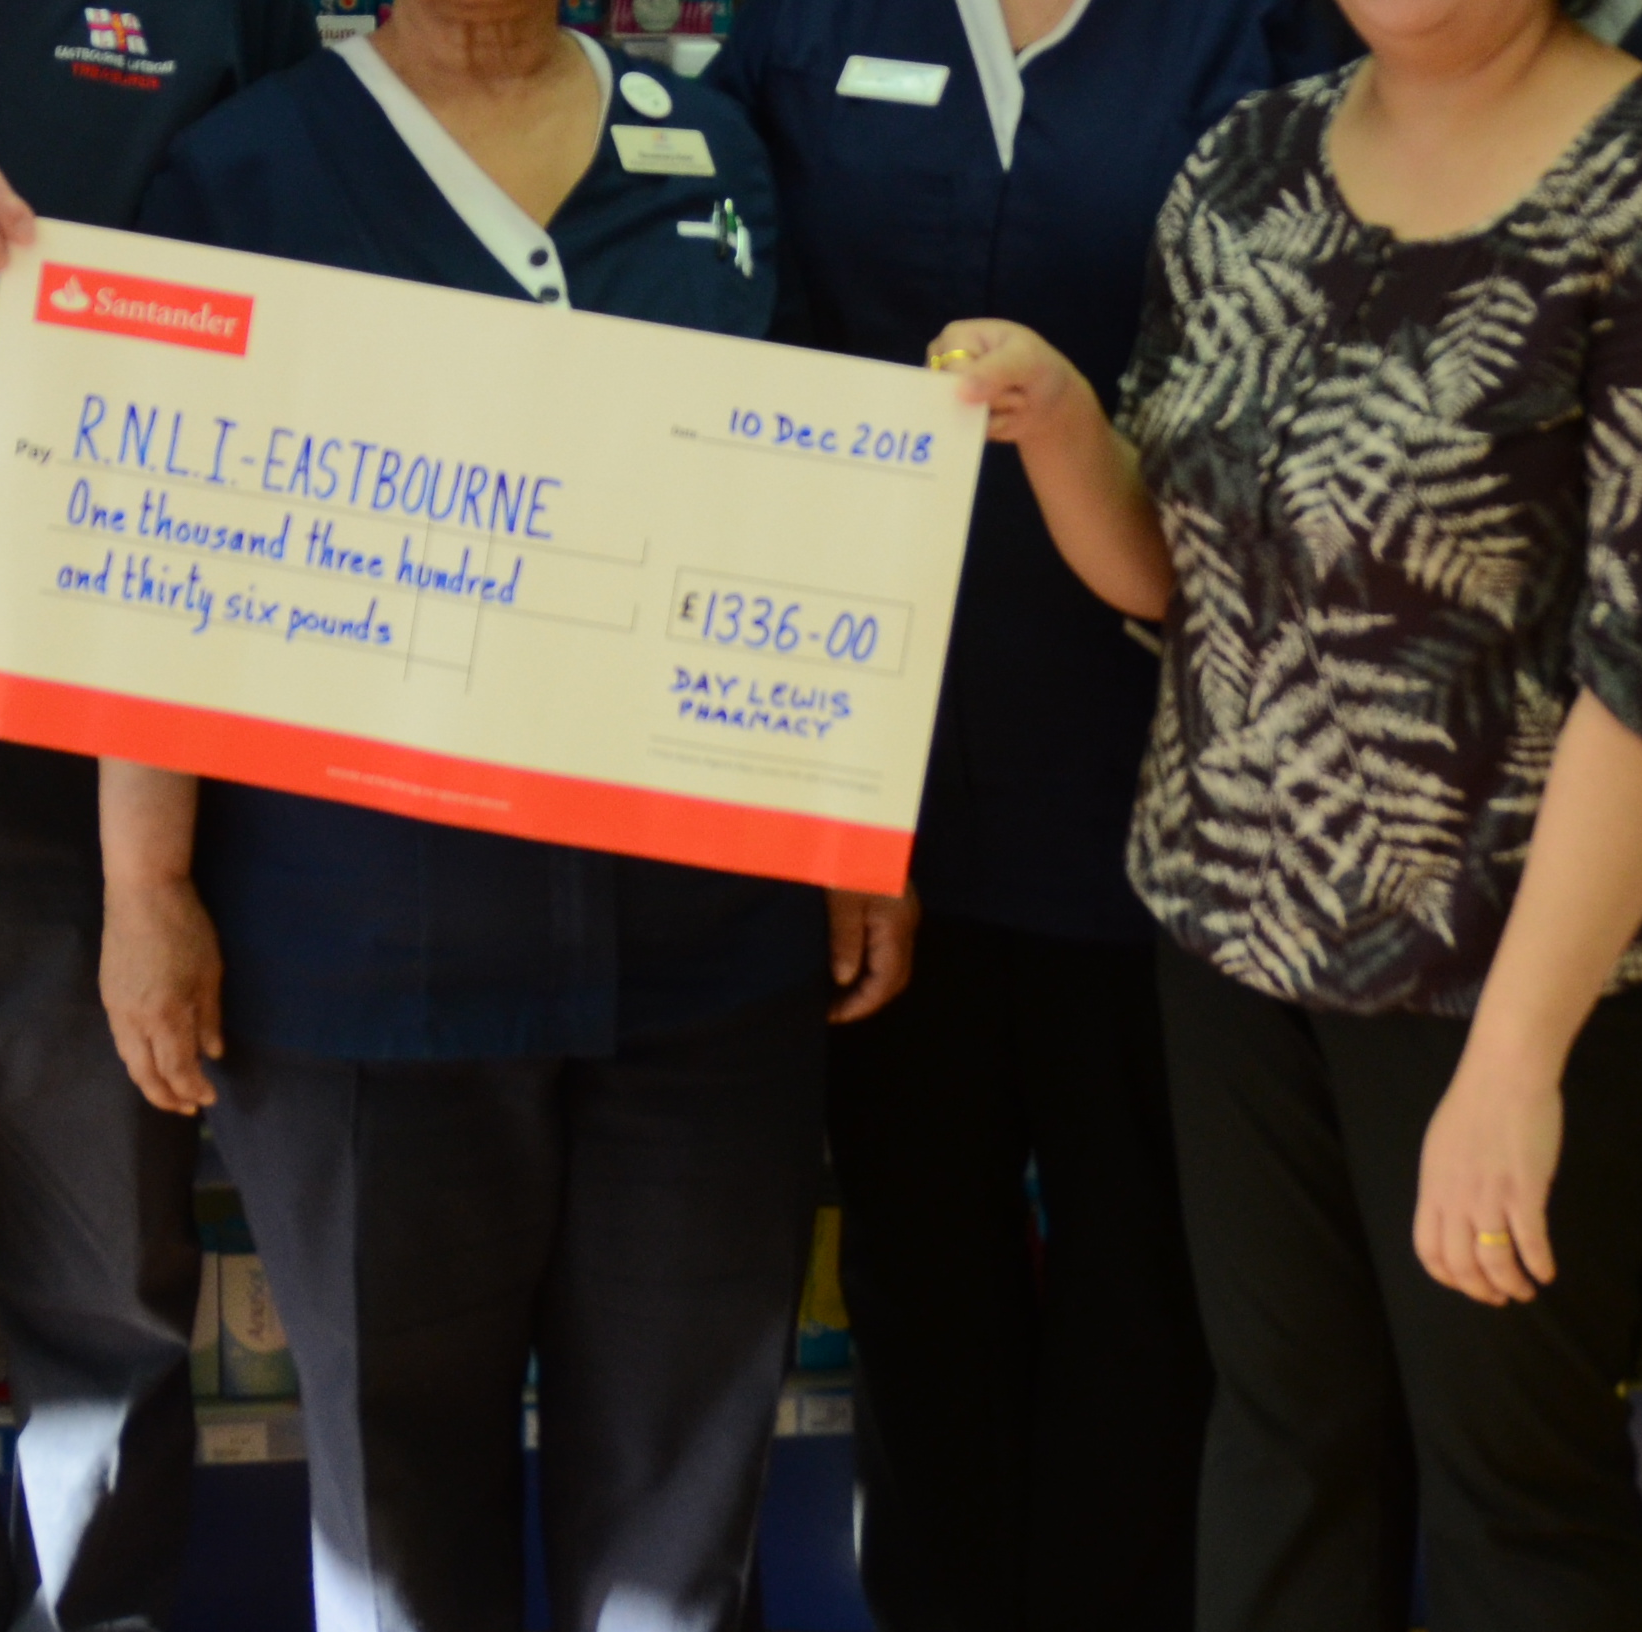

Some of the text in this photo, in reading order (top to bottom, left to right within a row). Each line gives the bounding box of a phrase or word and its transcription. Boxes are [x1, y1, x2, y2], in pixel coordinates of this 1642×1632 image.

[93, 287, 237, 338] Santander
[15, 437, 52, 464] Pay
[729, 408, 934, 463] 10 Dec 2018
[67, 478, 523, 605] One thousand three hundred
[57, 550, 393, 644] and thirty six pounds
[670, 665, 739, 697] DAY
[679, 699, 833, 739] PHARMACY
